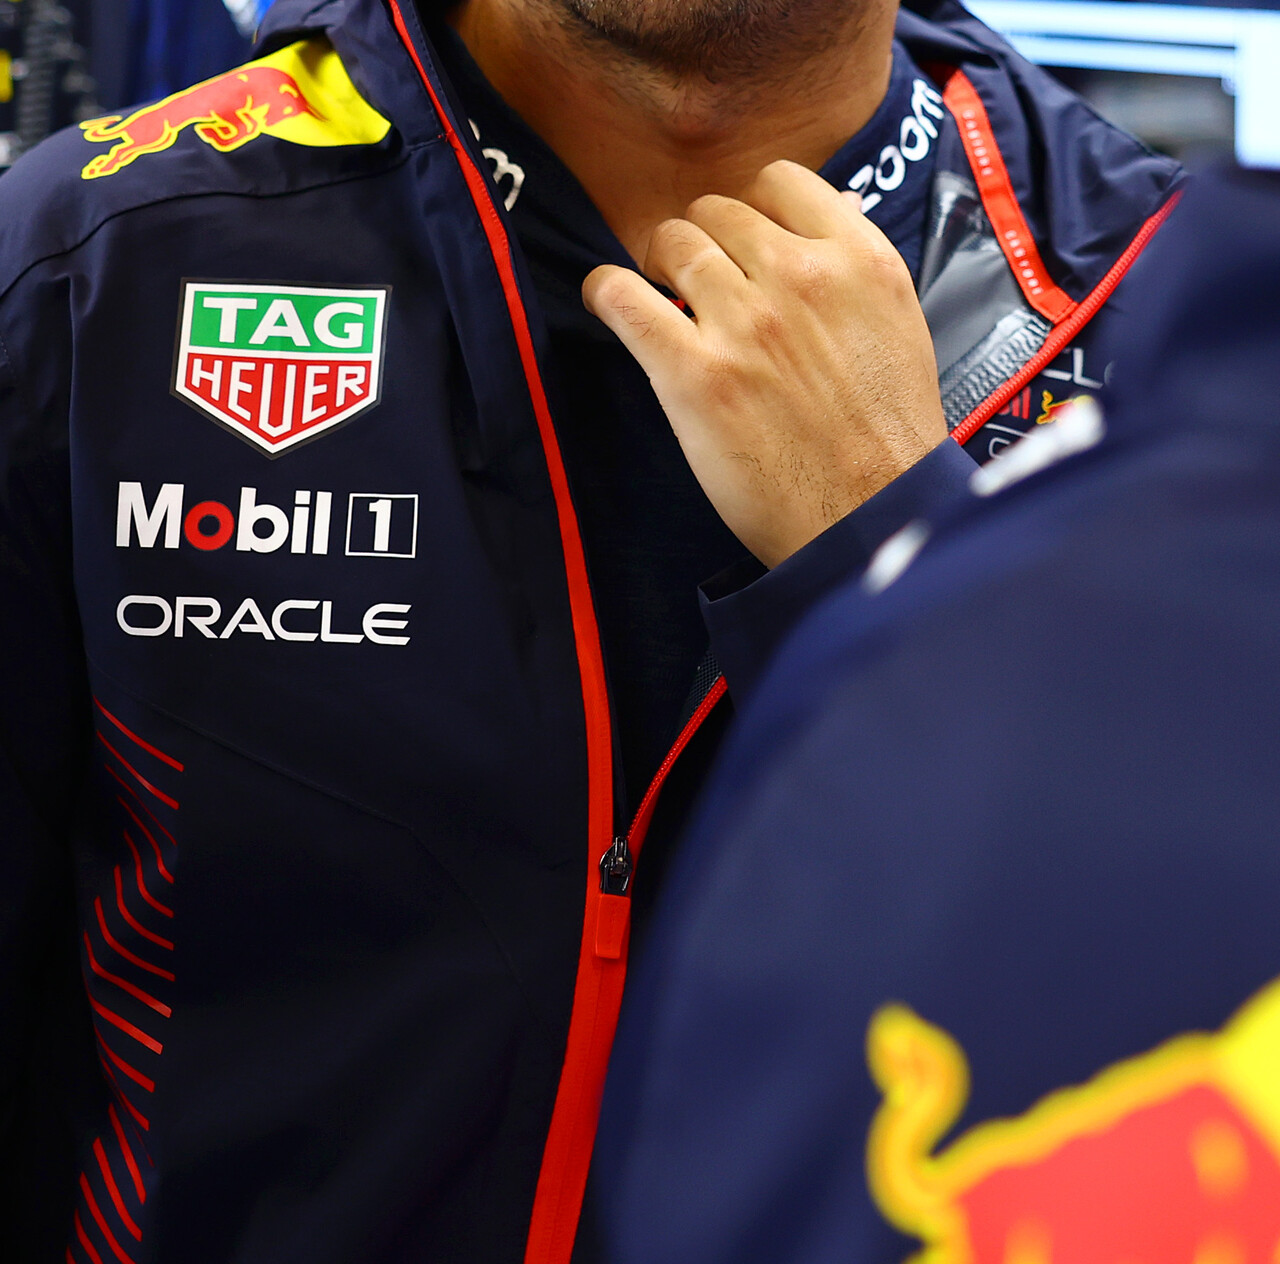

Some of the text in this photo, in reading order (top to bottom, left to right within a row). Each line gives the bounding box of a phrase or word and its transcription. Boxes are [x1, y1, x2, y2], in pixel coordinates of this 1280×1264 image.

[847, 79, 945, 214] zoom
[202, 296, 365, 349] TAG
[191, 357, 371, 438] HEUER
[116, 482, 332, 554] Mobil
[116, 594, 412, 645] ORACLE
